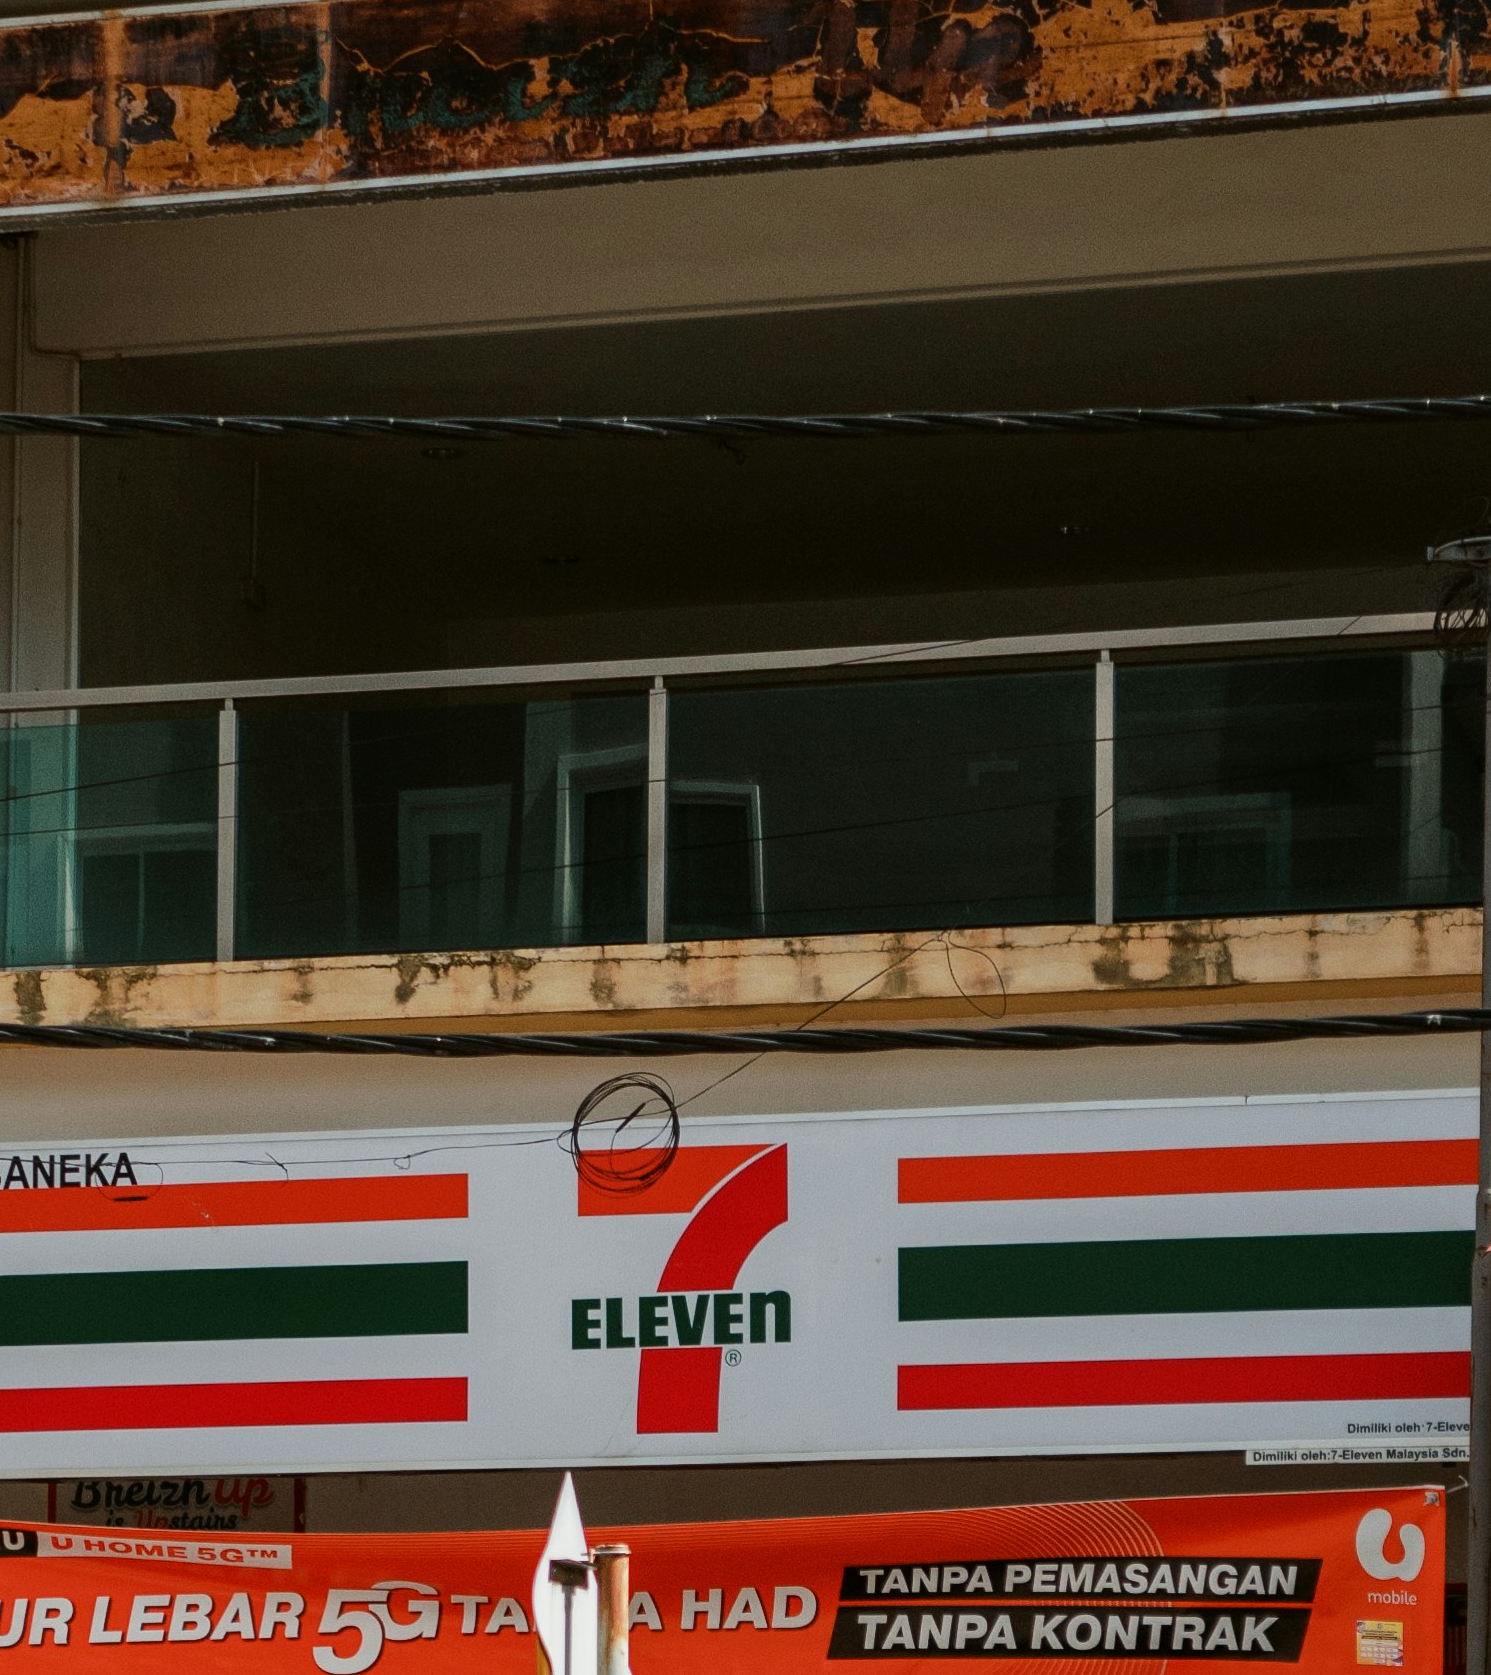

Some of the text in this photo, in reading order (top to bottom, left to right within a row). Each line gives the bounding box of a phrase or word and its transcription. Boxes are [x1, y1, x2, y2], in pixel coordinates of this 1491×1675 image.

[577, 1144, 789, 1434] 7
[1347, 1423, 1391, 1434] Dimiliki
[1427, 1421, 1470, 1433] 7-Eleve
[1253, 1447, 1470, 1463] Dimiliki Malaysia Sdn.
[51, 1536, 73, 1551] U
[84, 1539, 187, 1559] HOME
[860, 1562, 1298, 1596] TANPA PEMASANGAN
[1367, 1590, 1418, 1606] mobile
[88, 1591, 306, 1645] LEBAR
[311, 1580, 441, 1675] 5G
[451, 1591, 662, 1634] TAA
[681, 1585, 818, 1630] HAD
[858, 1613, 1279, 1653] TANPA KONTRAK
